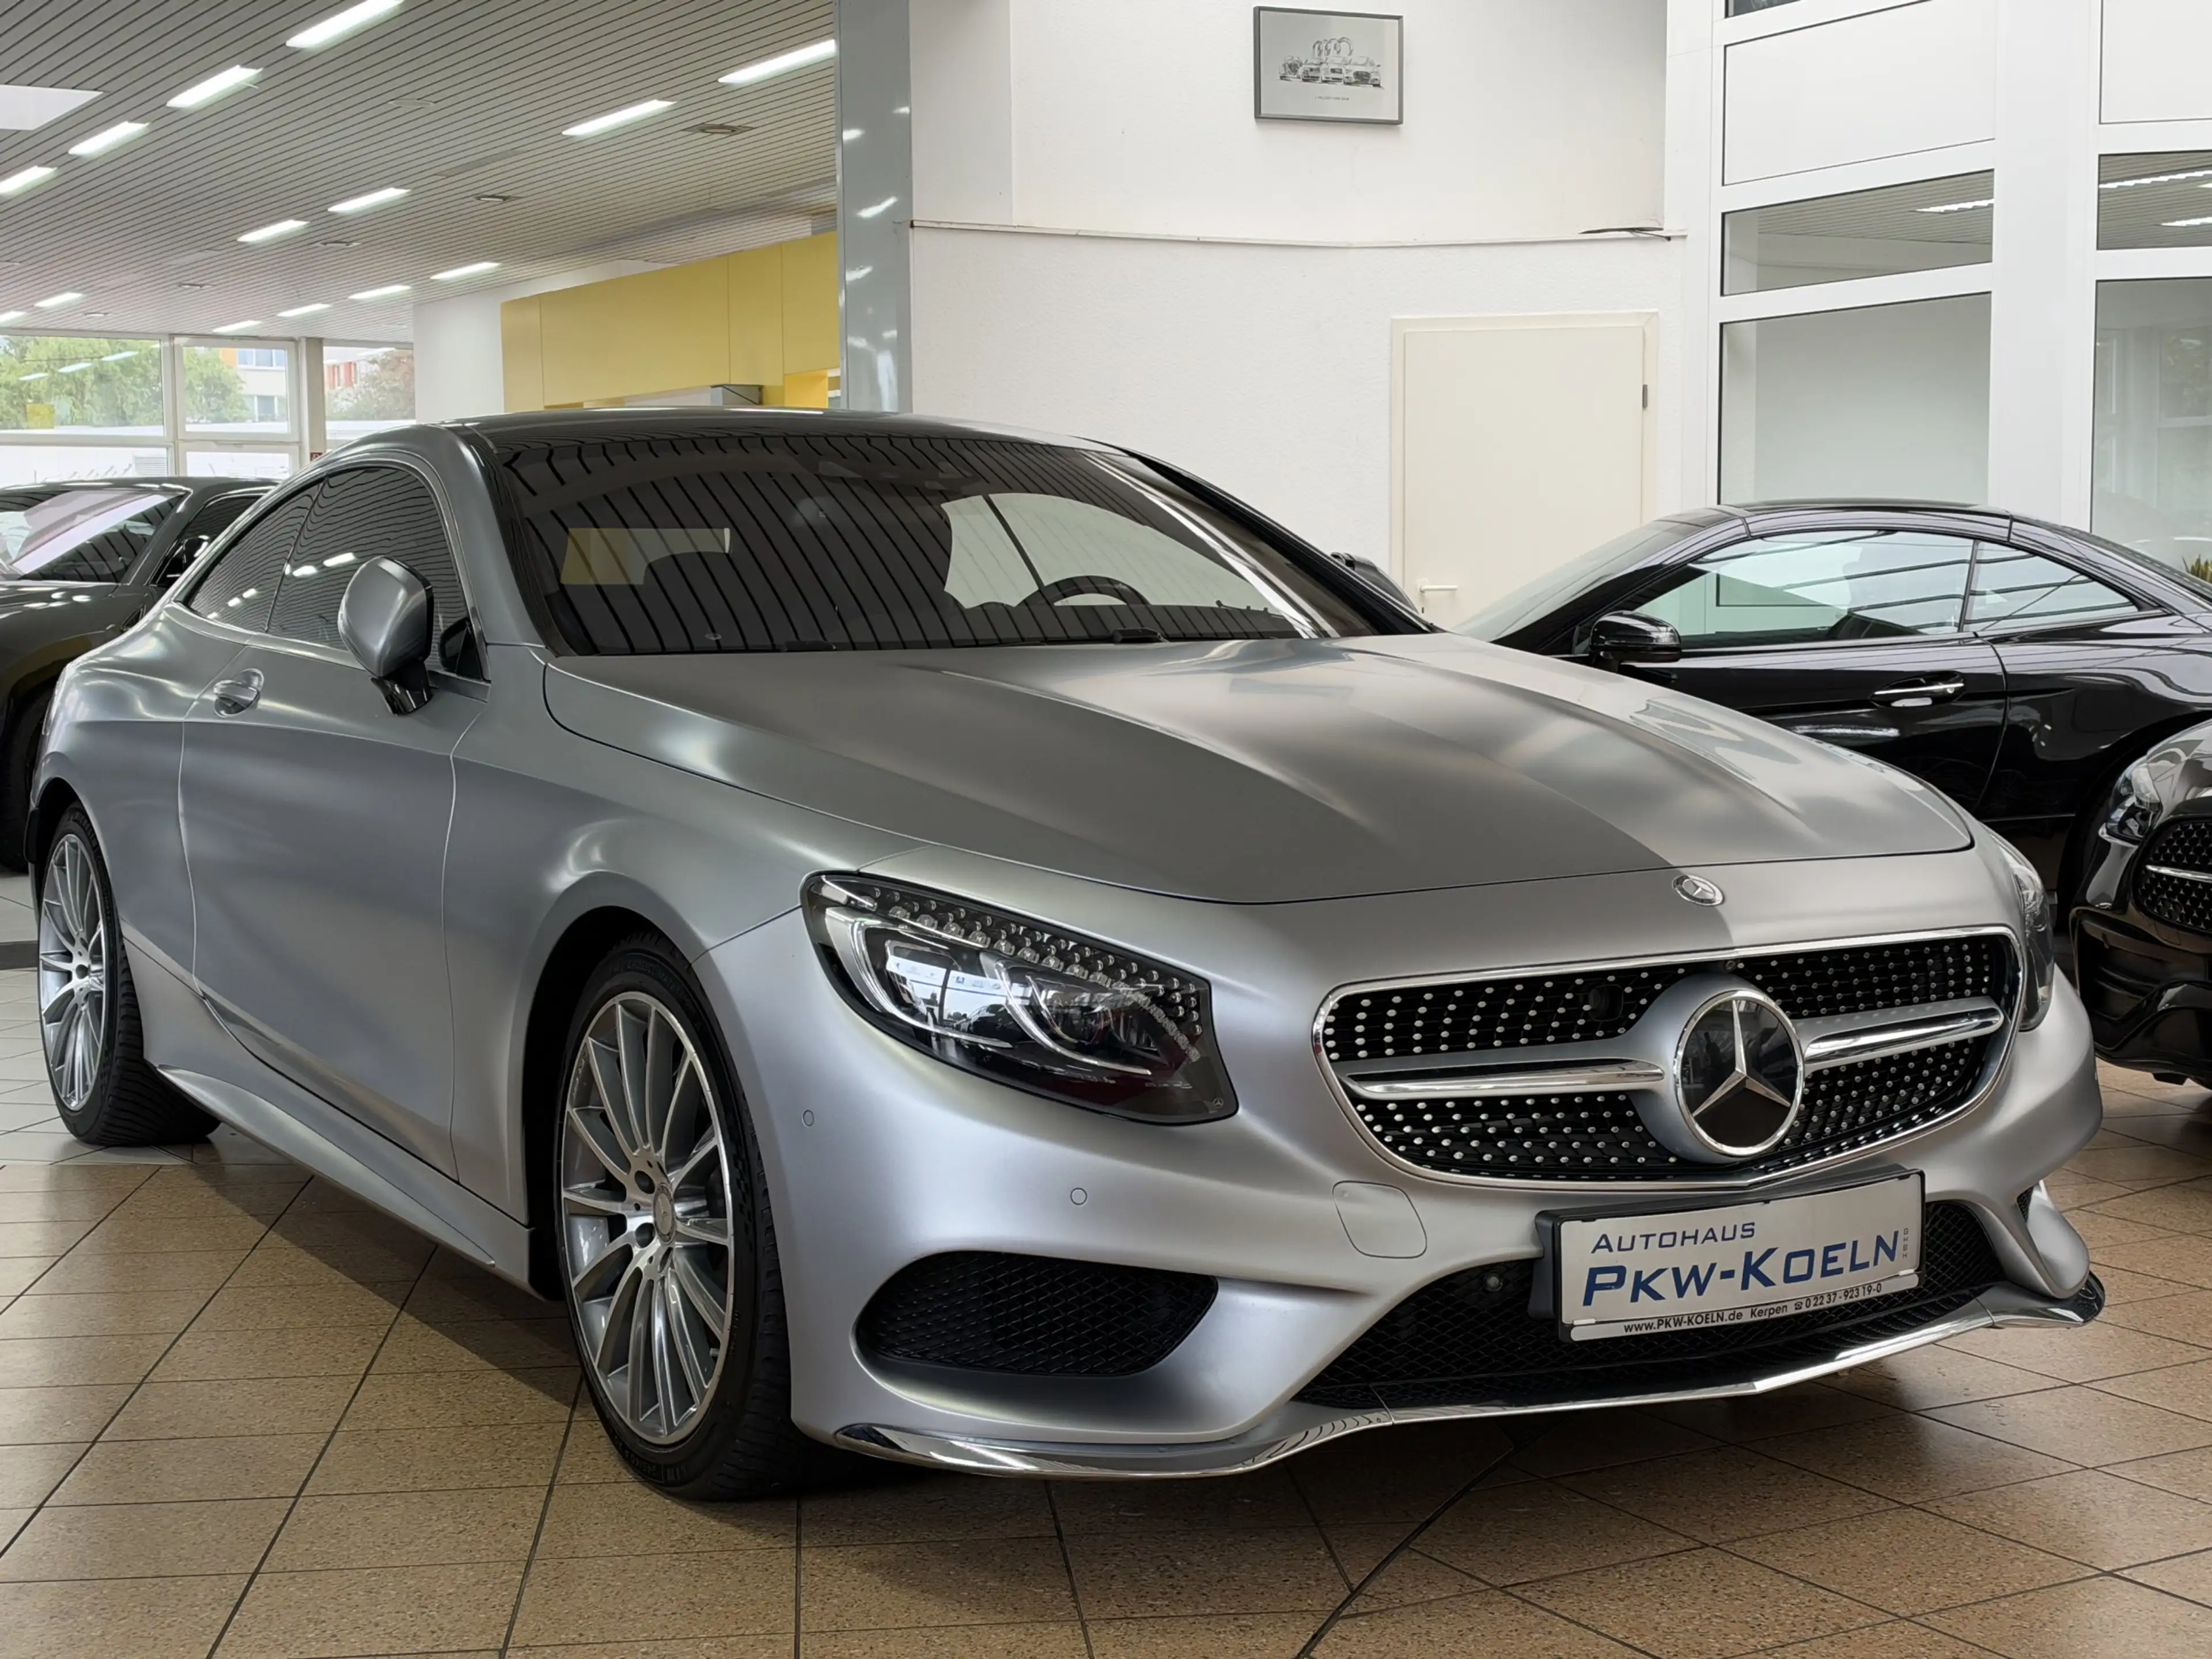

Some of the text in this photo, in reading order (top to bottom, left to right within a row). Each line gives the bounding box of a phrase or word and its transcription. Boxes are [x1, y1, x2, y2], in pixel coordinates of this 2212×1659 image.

[1590, 1222, 1756, 1253] AUTOHAUS
[1582, 1230, 1899, 1306] PKW-KOELN
[1623, 1310, 1743, 1334] www.PKW-KOELN.de
[1750, 1304, 1787, 1319] Kerpen
